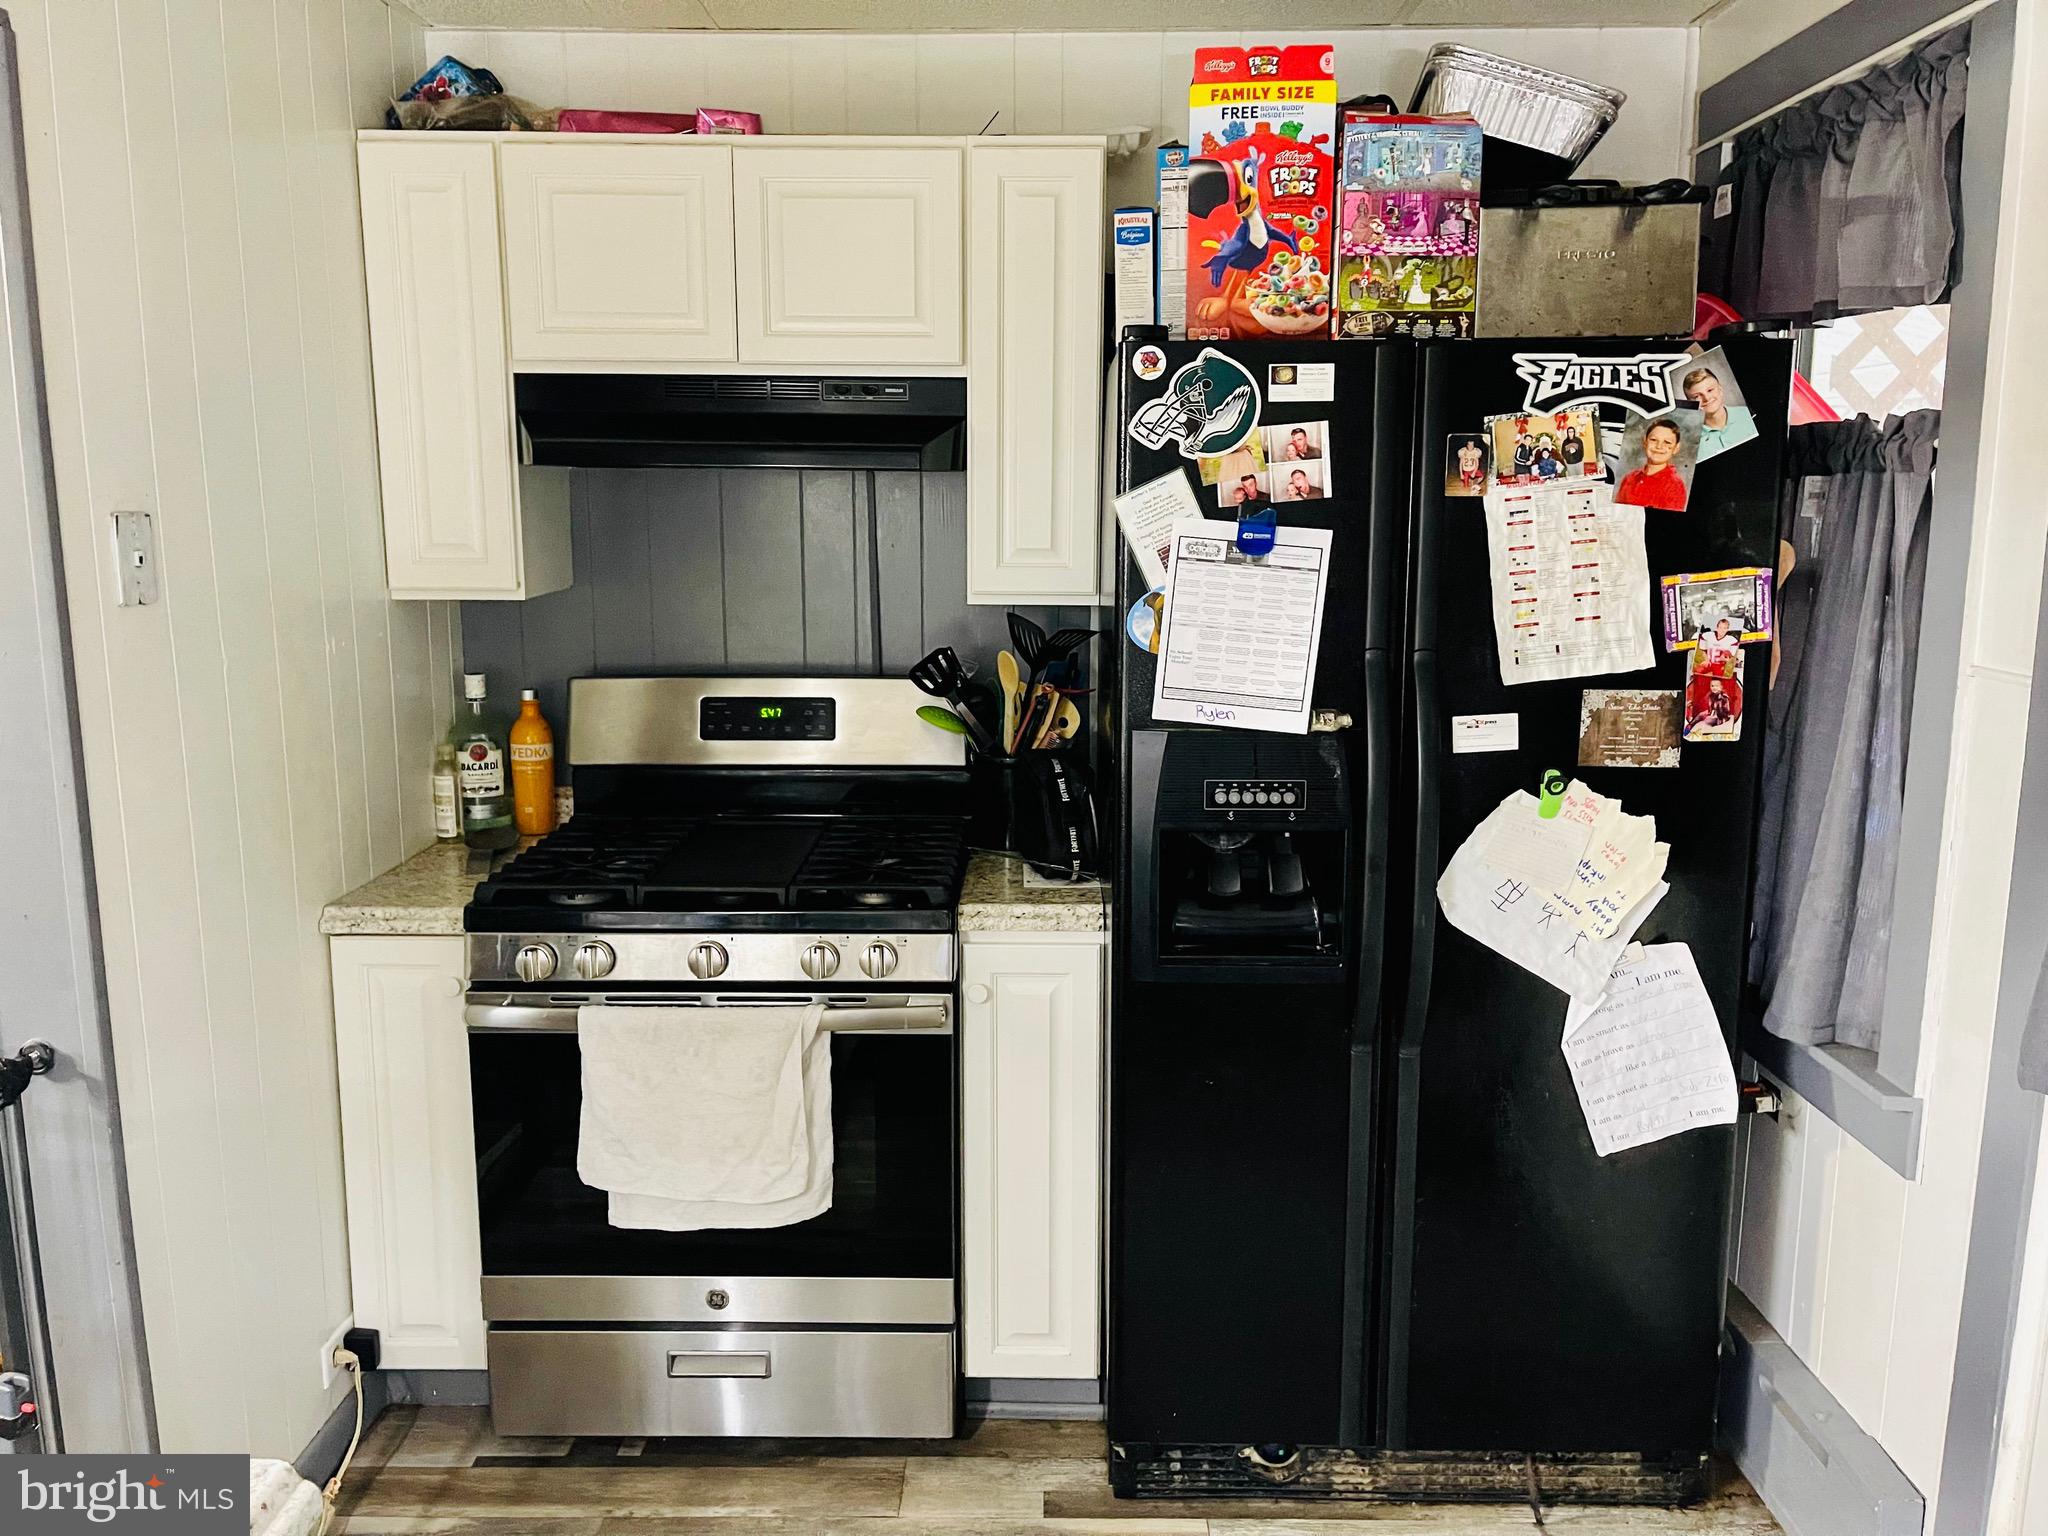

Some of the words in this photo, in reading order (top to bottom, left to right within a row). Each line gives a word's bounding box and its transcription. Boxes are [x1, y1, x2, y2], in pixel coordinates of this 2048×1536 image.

[1204, 60, 1236, 72] Kellogg's
[1248, 55, 1279, 67] FROOT
[1324, 57, 1331, 65] 9
[1250, 65, 1278, 76] LOOPS
[1210, 86, 1271, 101] FAMILY
[1277, 86, 1314, 99] SIZE
[1221, 105, 1259, 120] FREE
[1275, 150, 1313, 165] Kellogg's
[1270, 166, 1318, 184] FROOT
[1274, 180, 1316, 197] LOOPS
[1557, 250, 1616, 262] PRESTO
[1535, 360, 1668, 404] EAGLES
[1196, 704, 1236, 722] Rylen
[1644, 973, 1661, 984] am
[1573, 1037, 1585, 1047] am
[1586, 1034, 1595, 1042] as
[1596, 1024, 1619, 1038] smart
[1580, 1058, 1593, 1068] am
[1602, 1046, 1624, 1057] brave
[1625, 1063, 1641, 1072] like
[1593, 1097, 1605, 1105] am
[1616, 1085, 1638, 1096] sweet
[1696, 1108, 1710, 1117] am
[1599, 1116, 1612, 1125] am
[1617, 1132, 1631, 1141] am
